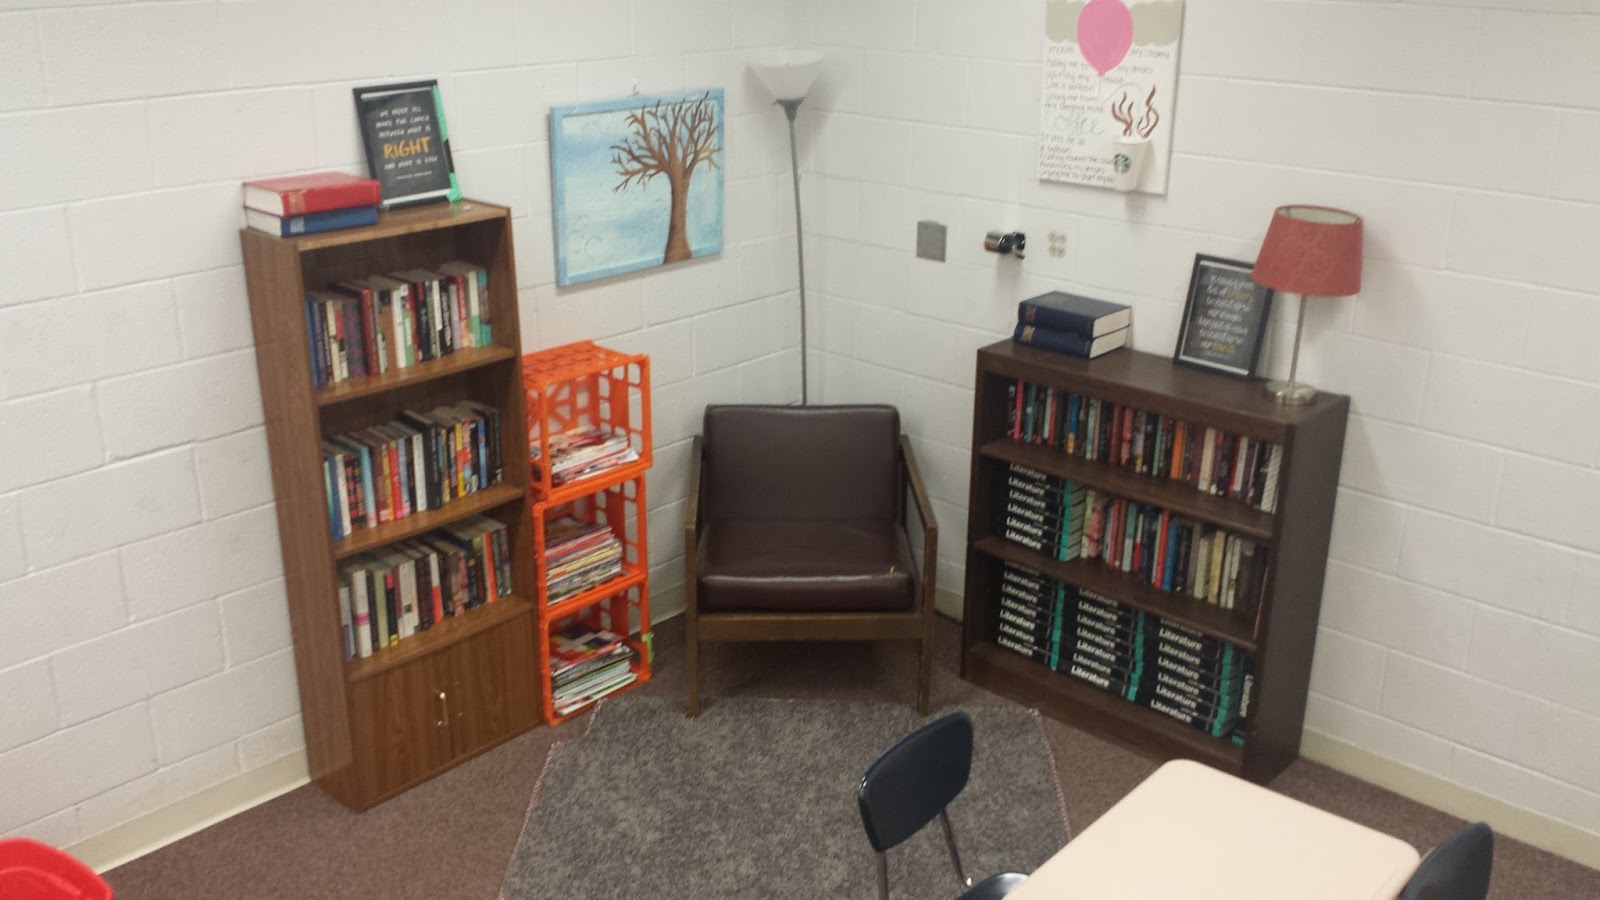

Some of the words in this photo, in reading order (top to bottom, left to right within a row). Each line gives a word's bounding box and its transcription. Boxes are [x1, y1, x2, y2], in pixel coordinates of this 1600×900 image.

[383, 136, 431, 159] RIGHT
[1008, 475, 1045, 496] Literature
[1009, 489, 1046, 509] Literature
[1007, 502, 1044, 522] Literature
[1006, 516, 1043, 536] Literature
[1005, 529, 1042, 550] Literature
[1004, 570, 1040, 591] Literature
[1001, 582, 1038, 604] Literature
[1001, 597, 1037, 618] Literature
[1078, 600, 1118, 621] Literature
[1000, 608, 1036, 631] Literature
[1077, 614, 1116, 635] Literature
[999, 622, 1035, 643] Literature
[1077, 627, 1116, 649] Literature
[1159, 627, 1202, 651] Literature
[997, 635, 1033, 657] Literature
[1077, 640, 1116, 662] Literature
[1159, 642, 1200, 665] Literature
[1073, 652, 1112, 675] Literature
[1158, 656, 1200, 680] Literature
[1071, 664, 1110, 688] Literature
[1158, 672, 1200, 695] Literature
[1156, 684, 1197, 709] Literature
[1150, 699, 1192, 723] Literature
